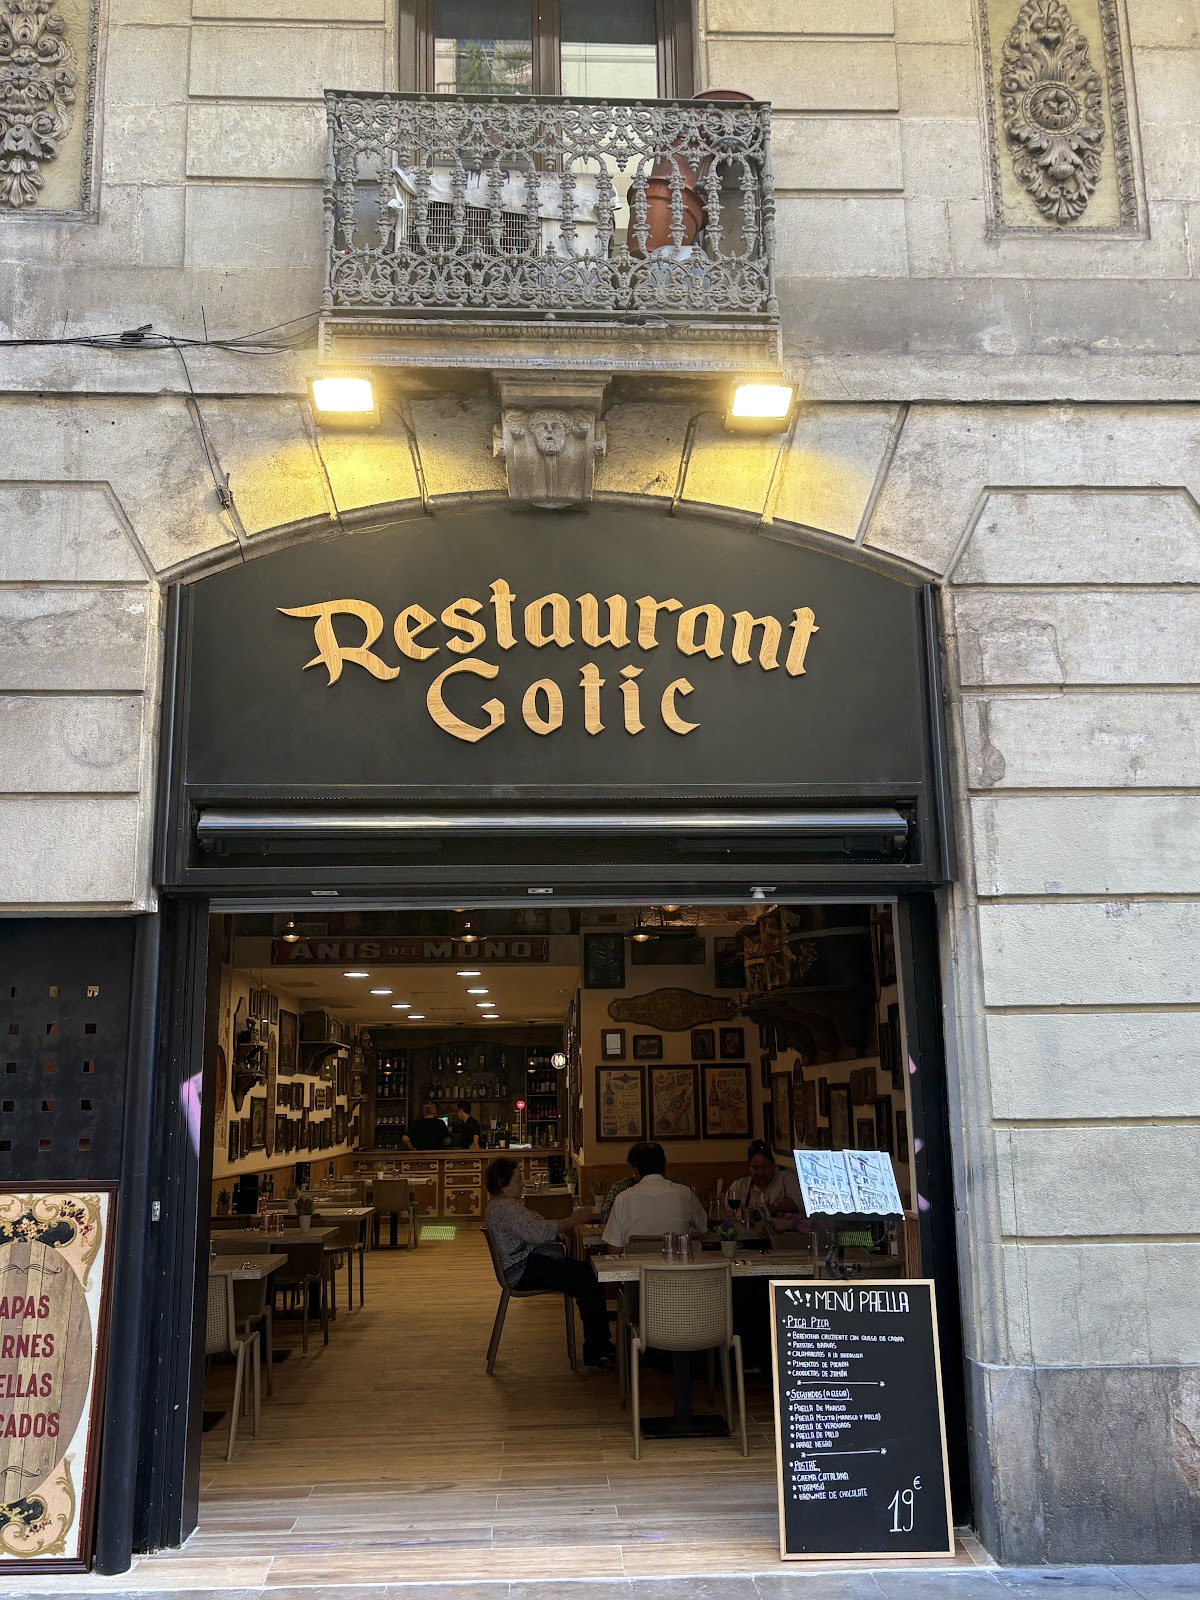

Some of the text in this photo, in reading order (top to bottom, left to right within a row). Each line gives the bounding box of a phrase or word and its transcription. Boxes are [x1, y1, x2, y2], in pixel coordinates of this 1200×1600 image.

[275, 577, 820, 687] Restaurant
[426, 658, 701, 743] Gotic
[288, 941, 533, 960] ANIS DEL MONO
[814, 1288, 854, 1312] MENÚ
[858, 1290, 909, 1313] PAELLA
[821, 1370, 829, 1378] DE
[815, 1422, 823, 1430] DE
[815, 1431, 824, 1439] DE
[824, 1430, 840, 1439] POLLO
[814, 1440, 833, 1448] NEGRO
[796, 1471, 850, 1482] CREMA CATALANA
[798, 1487, 869, 1501] BROWNIE DE CHOCOLATE
